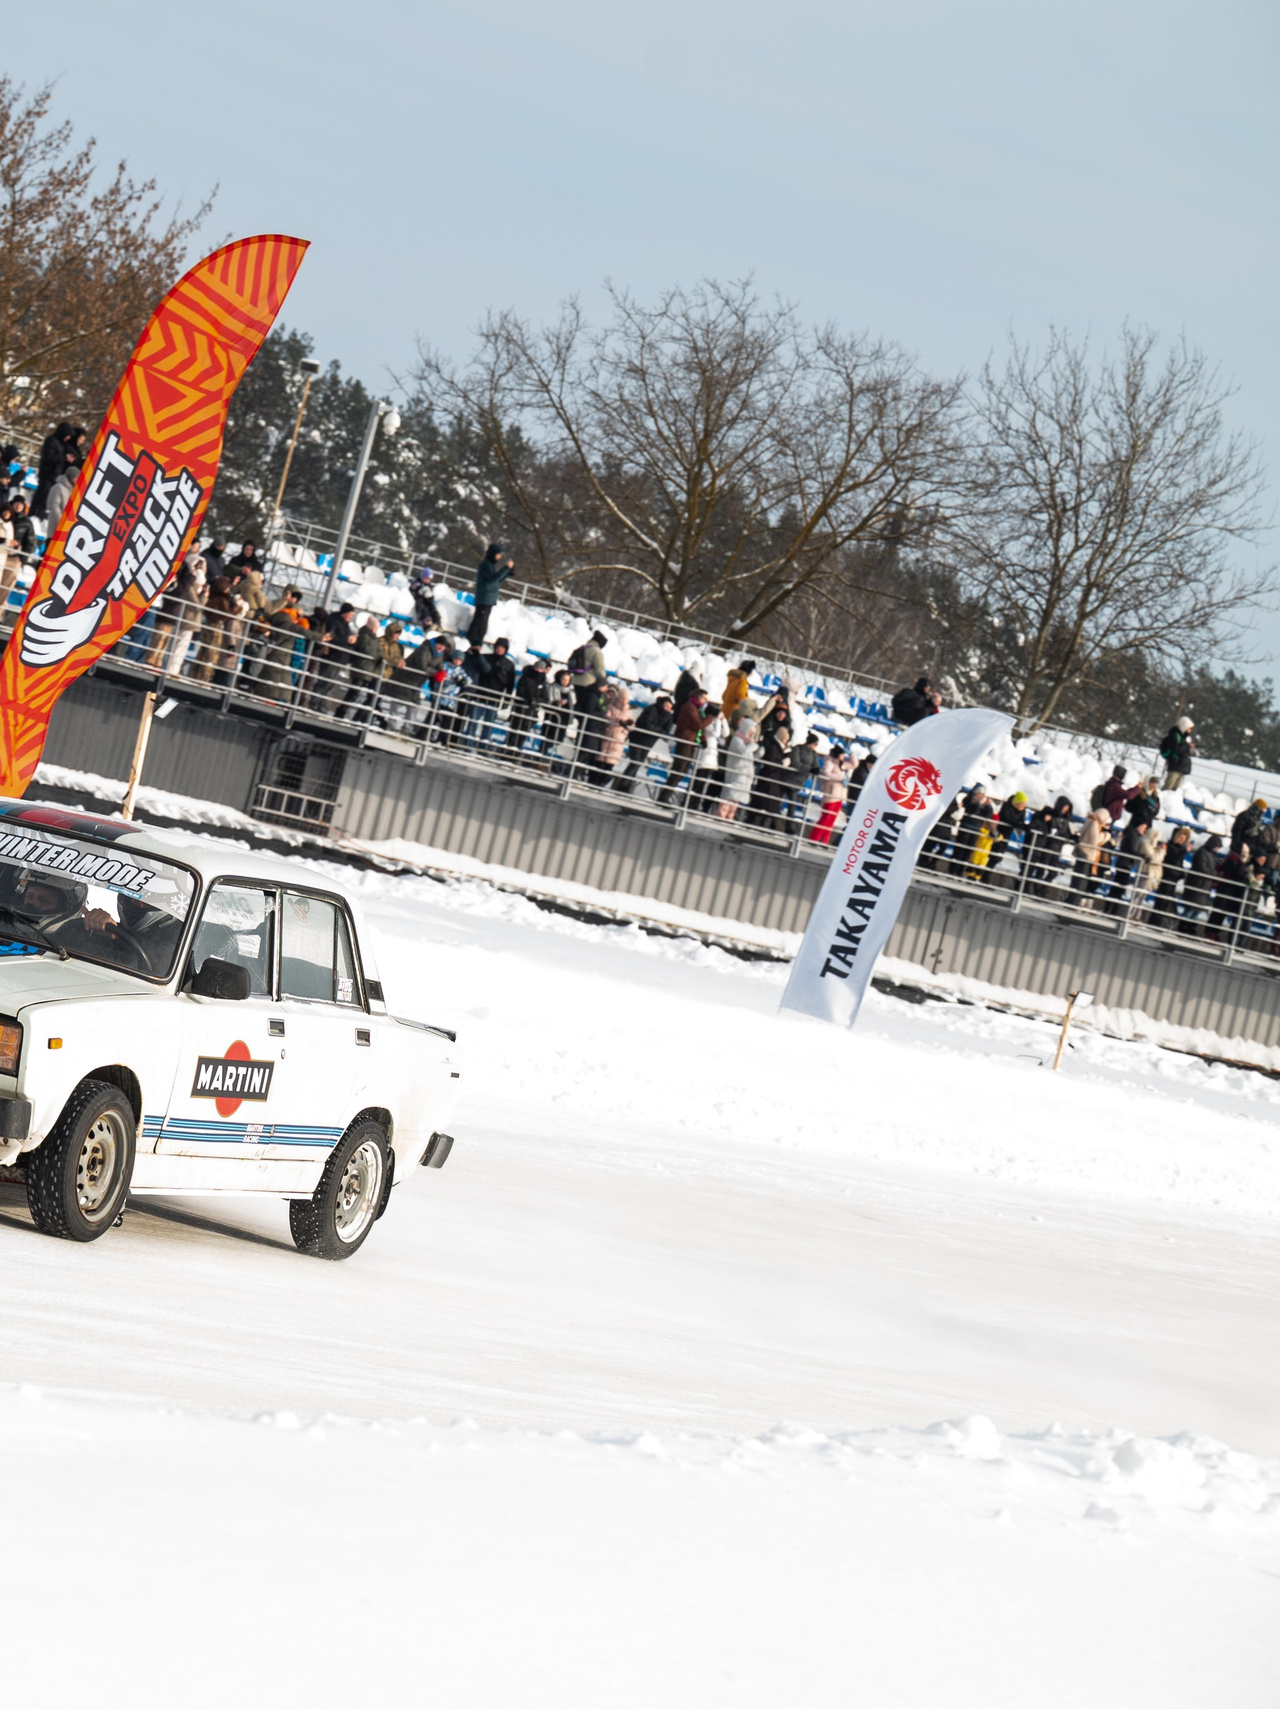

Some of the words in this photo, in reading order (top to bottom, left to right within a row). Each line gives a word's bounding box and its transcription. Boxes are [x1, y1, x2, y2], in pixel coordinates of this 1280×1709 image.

[50, 434, 135, 605] DRIFT
[105, 468, 179, 598] TRACK
[112, 474, 148, 542] EXPO
[135, 471, 200, 599] MODE
[70, 853, 156, 892] MODE
[842, 830, 869, 875] MOTOR
[862, 808, 879, 831] OIL
[819, 811, 908, 980] TAKAYAMA
[196, 1064, 269, 1094] MARTINI
